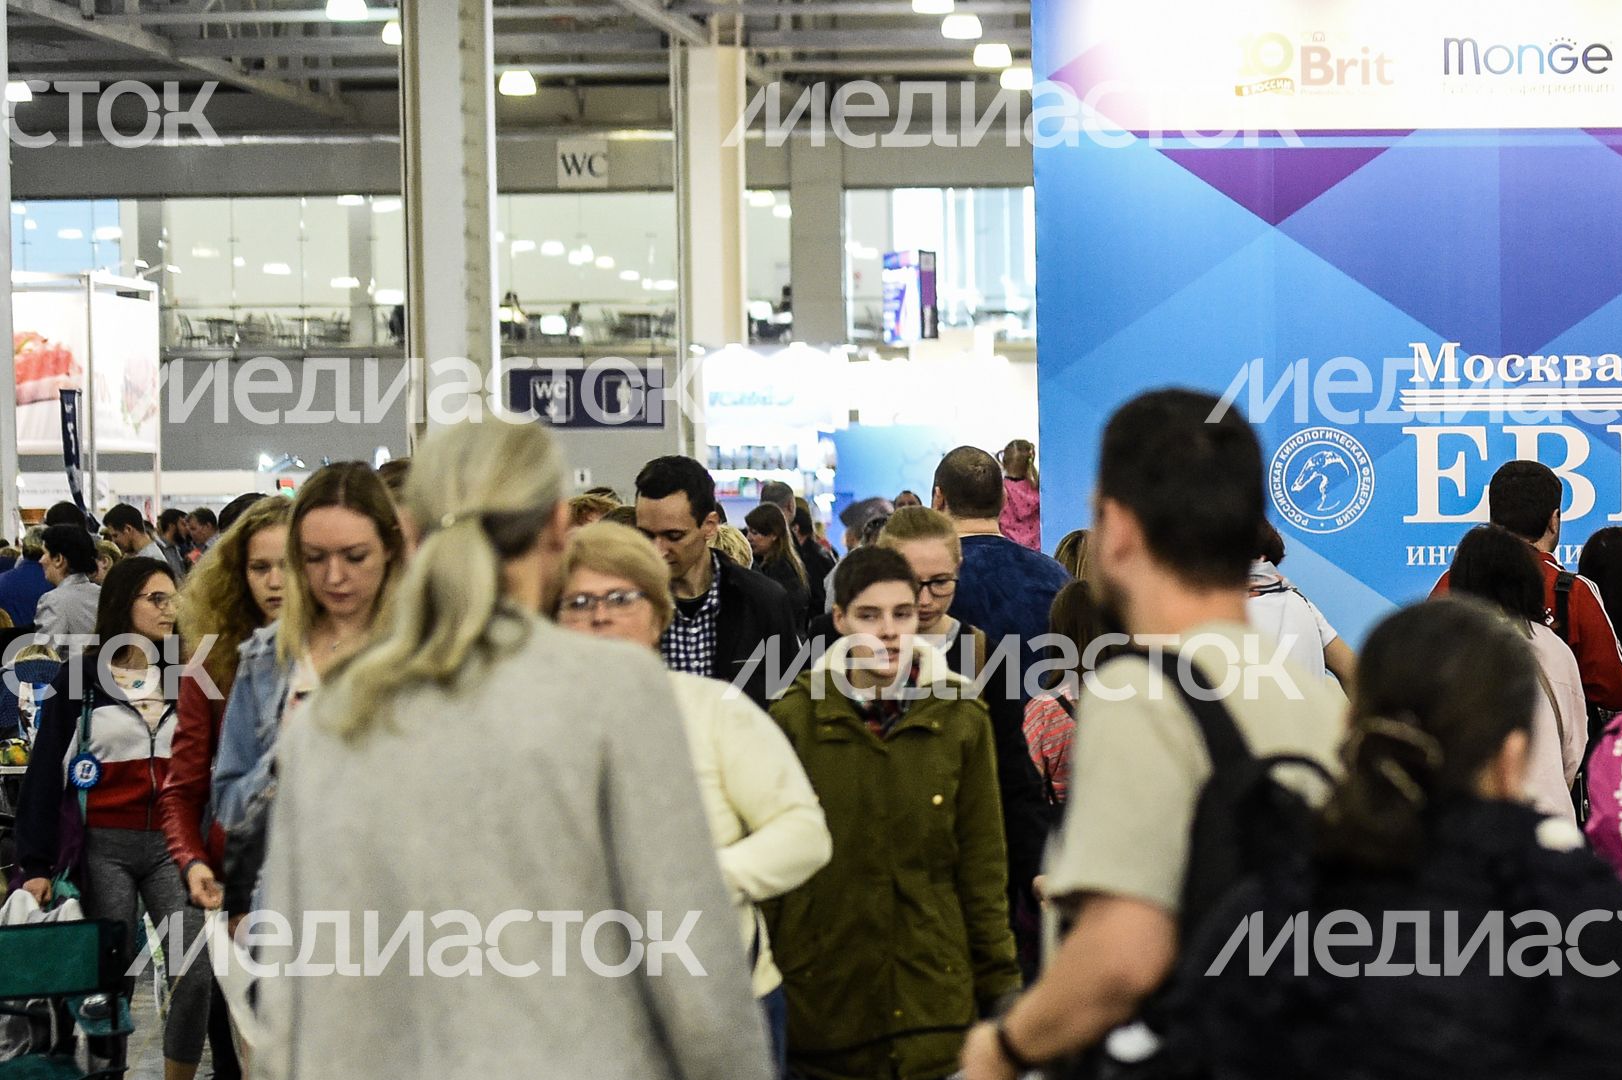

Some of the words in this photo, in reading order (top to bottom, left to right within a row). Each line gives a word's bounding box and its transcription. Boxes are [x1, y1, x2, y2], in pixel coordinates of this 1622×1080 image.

[1300, 45, 1394, 87] Brit
[561, 150, 608, 178] WC
[1279, 430, 1367, 465] КИНОЛОГИЧЕСКАЯ
[1335, 466, 1372, 527] ФЕДЕРАЦИЯ
